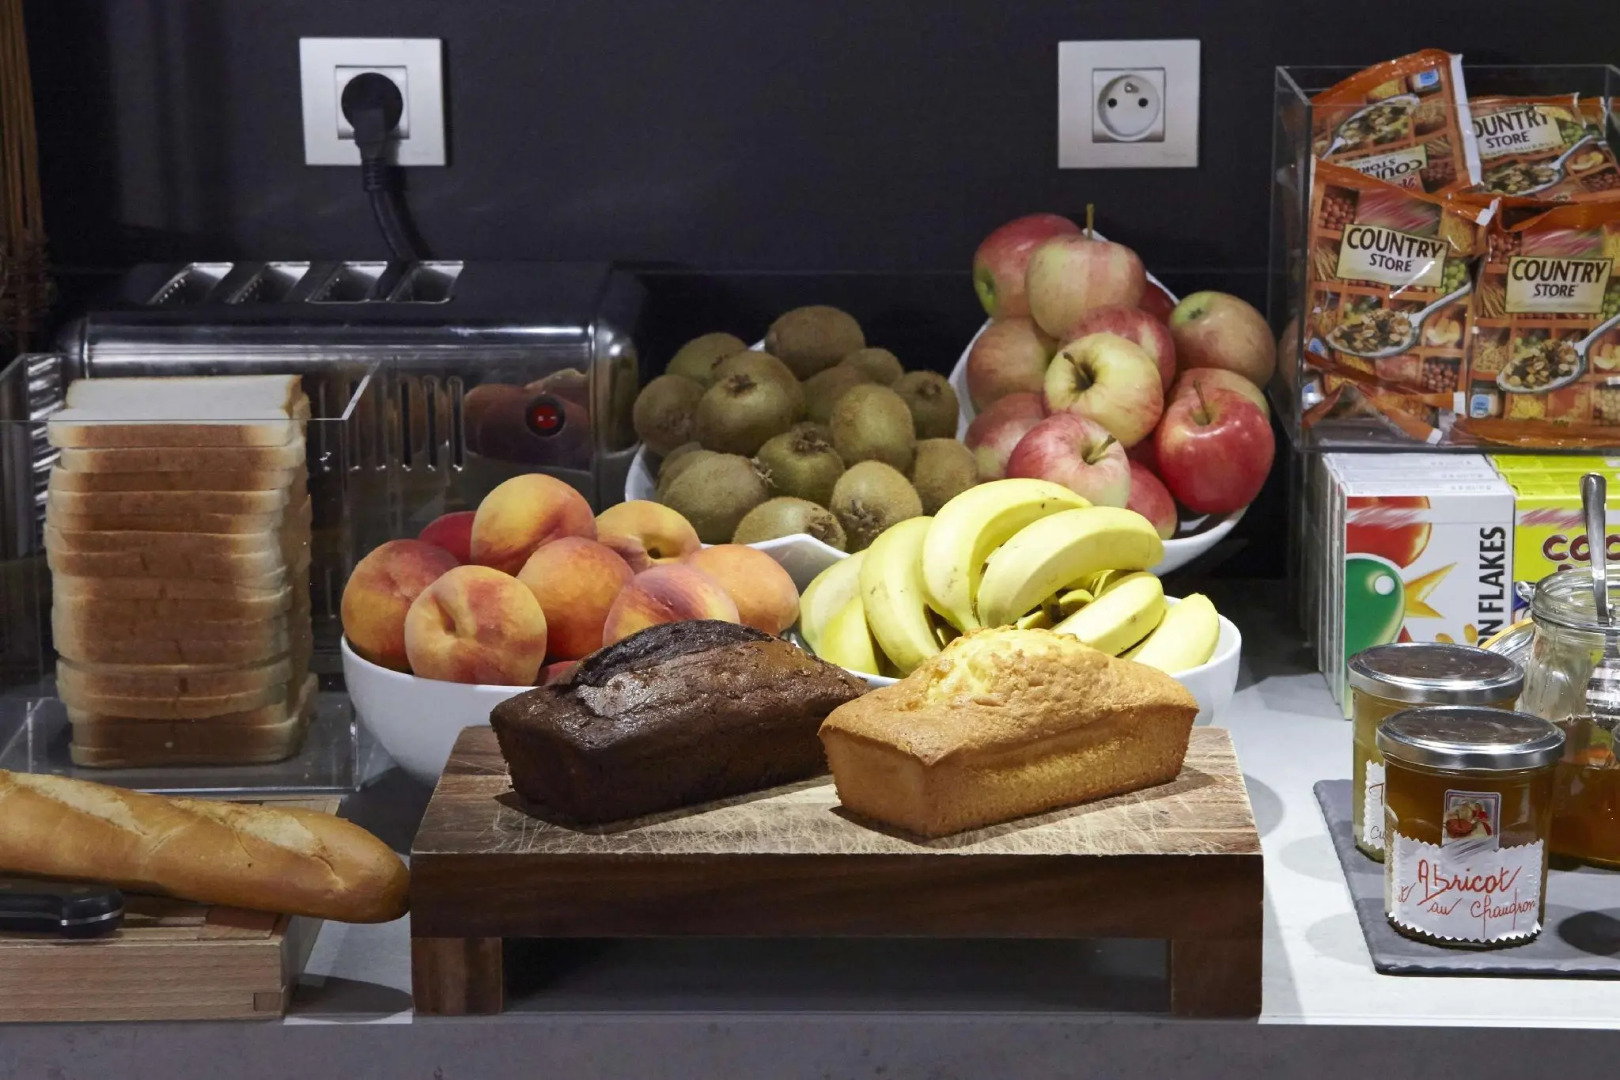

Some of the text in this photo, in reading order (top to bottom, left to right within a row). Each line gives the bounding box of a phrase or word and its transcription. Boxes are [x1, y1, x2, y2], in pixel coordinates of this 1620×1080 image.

[1472, 106, 1549, 138] OUNTRY
[1486, 131, 1531, 149] STORE
[1347, 227, 1443, 259] COUNTRY
[1369, 253, 1412, 272] STORE
[1512, 259, 1607, 284] COUNTRY
[1534, 283, 1575, 298] STORE
[1542, 534, 1620, 561] COC
[1479, 526, 1506, 613] FLAKES
[1417, 859, 1522, 906] Abricot
[1428, 898, 1463, 916] au
